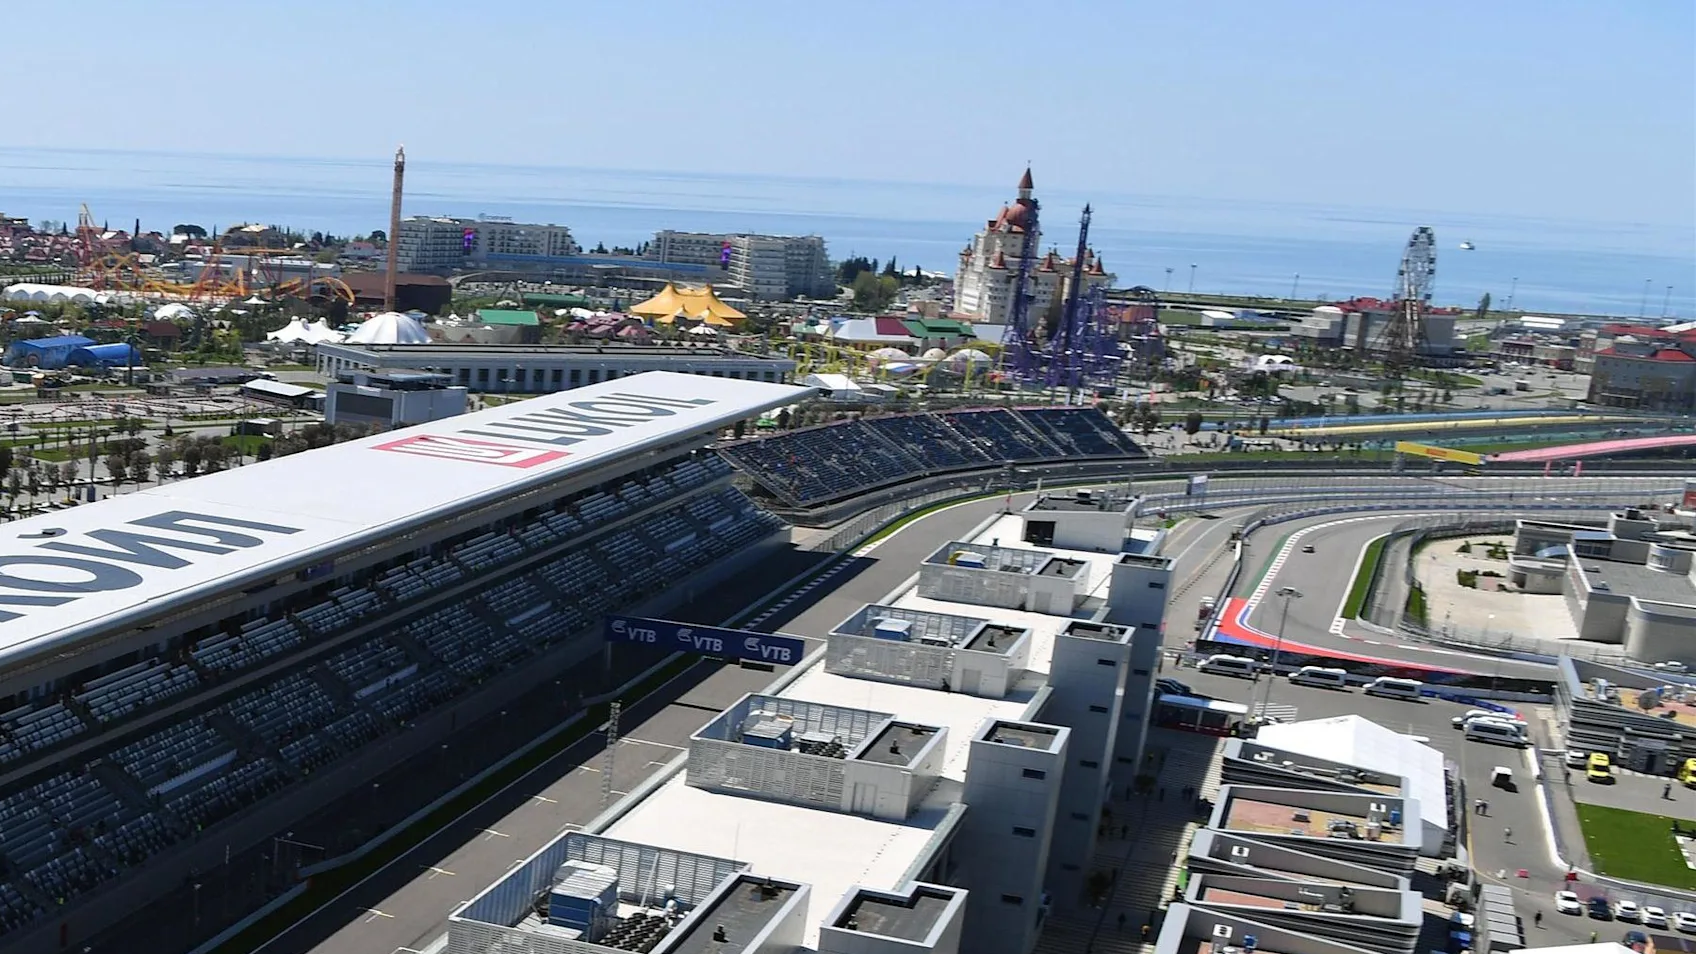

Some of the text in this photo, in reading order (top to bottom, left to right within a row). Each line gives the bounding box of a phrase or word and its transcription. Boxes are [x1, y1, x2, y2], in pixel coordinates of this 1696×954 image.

[456, 392, 718, 446] LUKOIL
[627, 627, 656, 643] VTB
[693, 636, 723, 652] VTB
[760, 644, 791, 661] VTB
